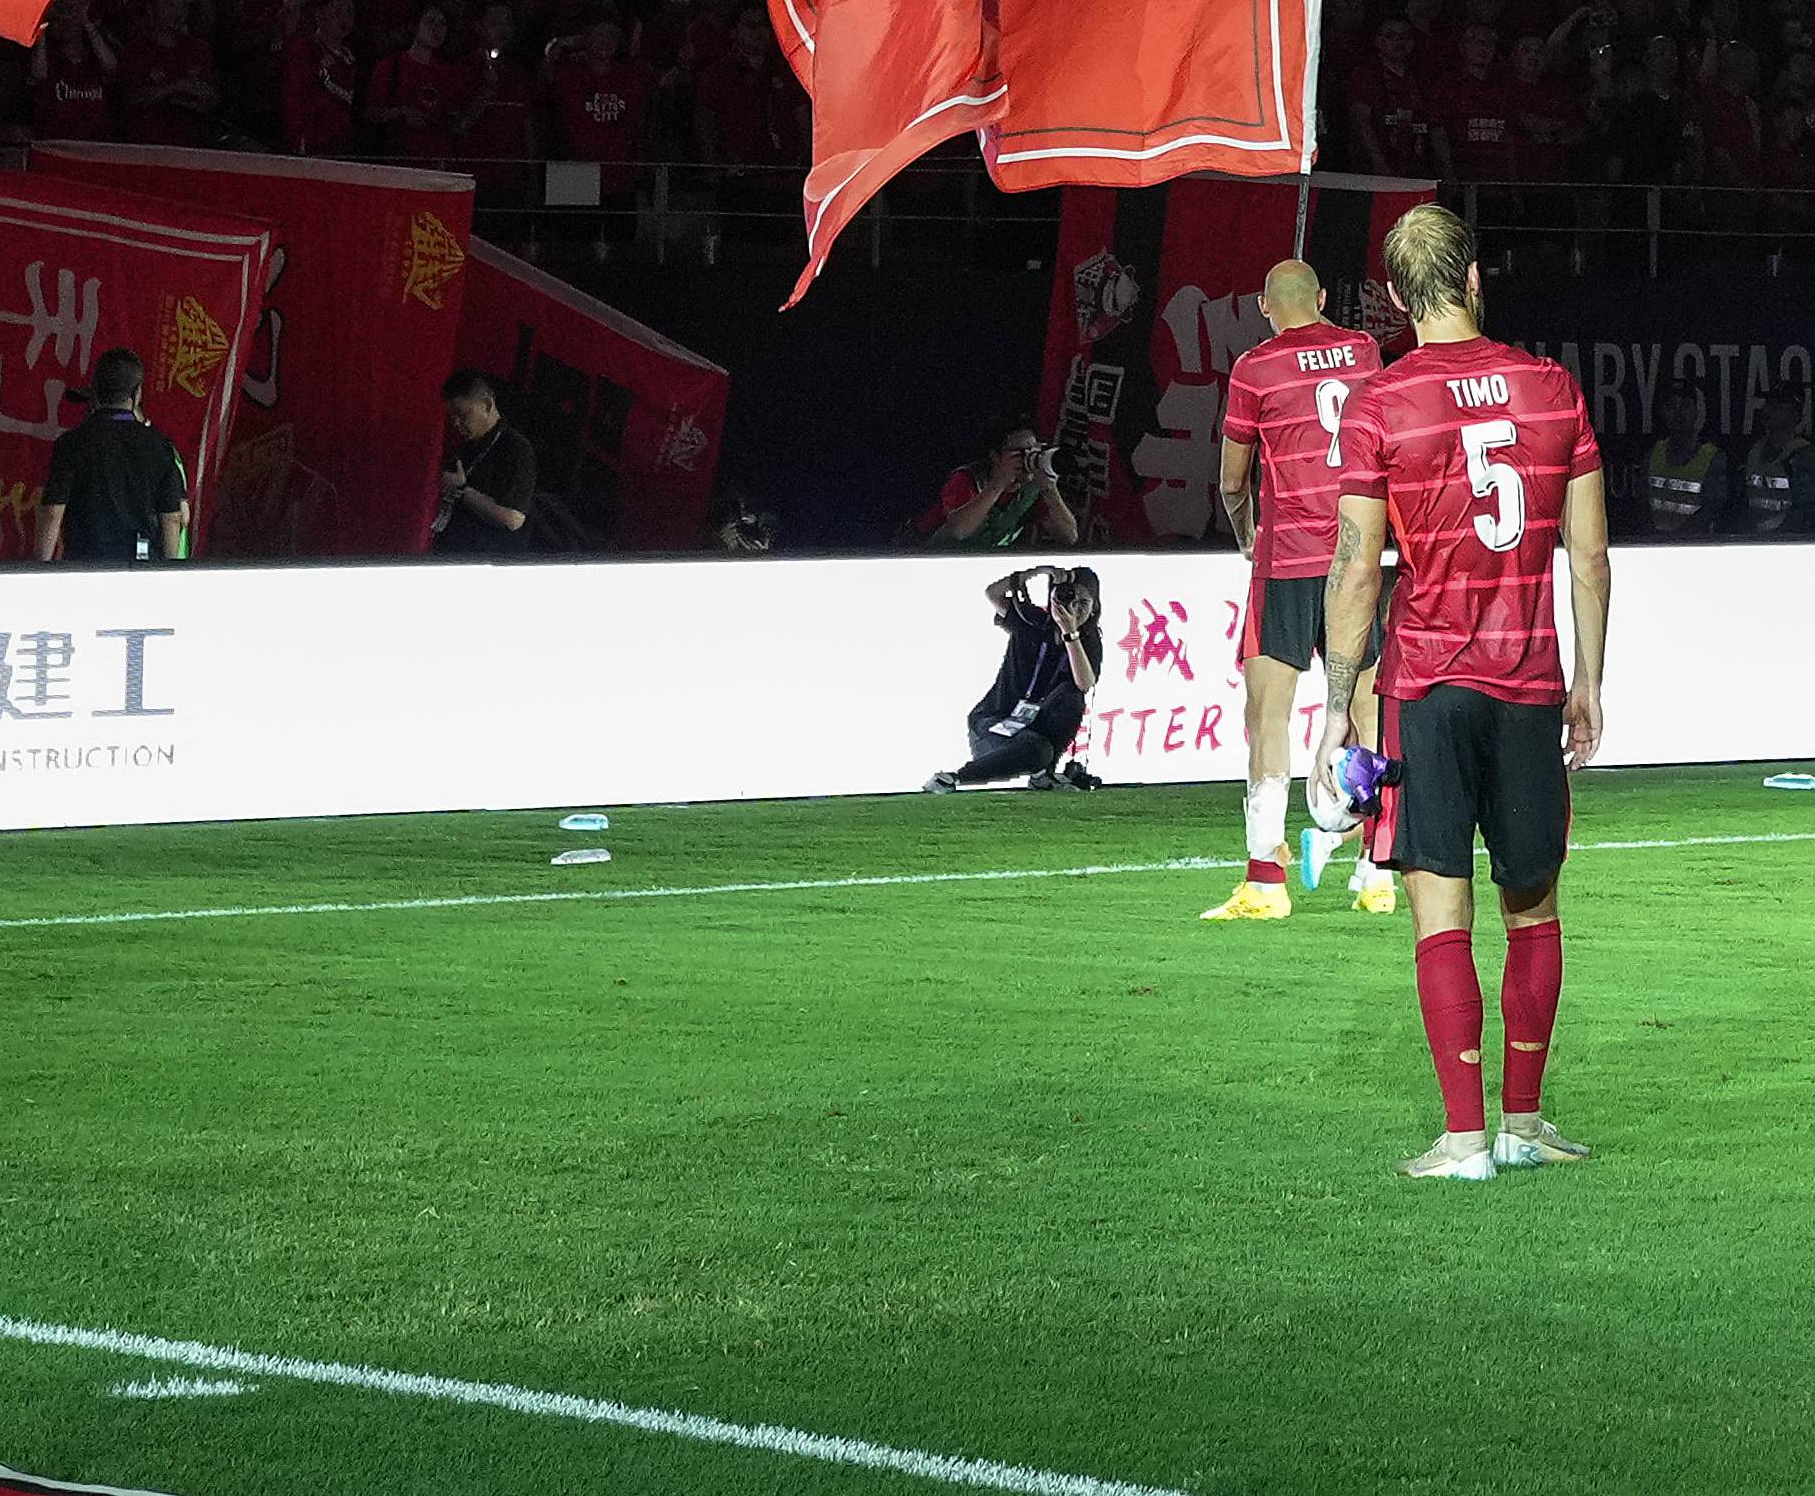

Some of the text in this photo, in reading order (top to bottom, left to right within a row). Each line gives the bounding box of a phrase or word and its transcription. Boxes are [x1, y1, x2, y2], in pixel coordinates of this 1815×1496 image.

[1297, 344, 1357, 372] FELIPE
[1447, 373, 1509, 409] TIMO
[1314, 378, 1351, 468] 9
[1460, 419, 1526, 553] 5
[1066, 704, 1223, 757] ETTER
